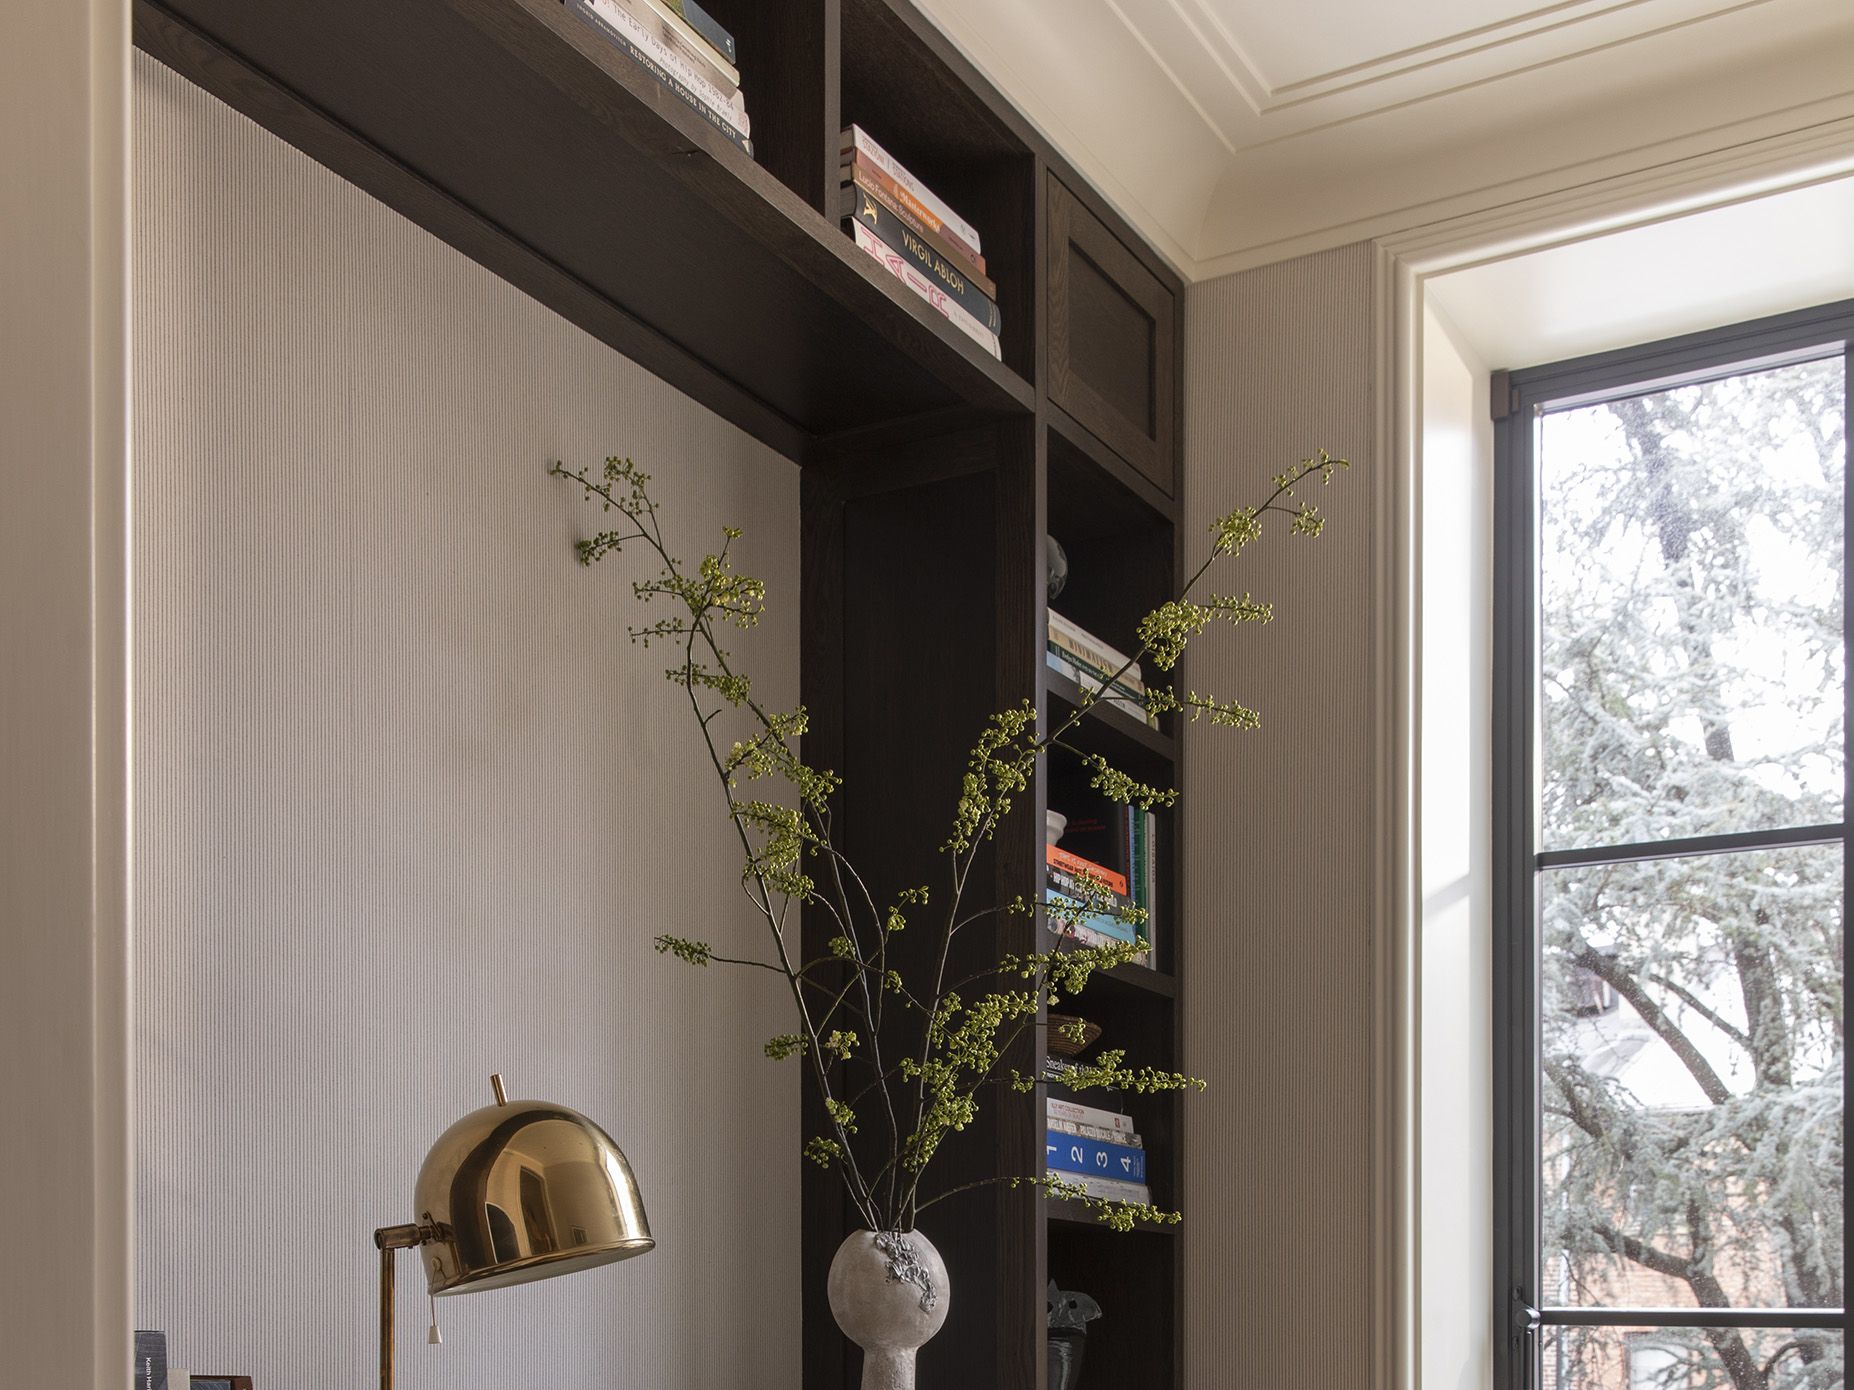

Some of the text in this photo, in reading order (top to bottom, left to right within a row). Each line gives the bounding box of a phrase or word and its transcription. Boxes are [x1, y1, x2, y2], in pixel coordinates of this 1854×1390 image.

[614, 4, 627, 22] The
[628, 17, 650, 41] Early
[650, 36, 668, 56] Days
[629, 45, 667, 81] RESTORING
[675, 83, 698, 107] HOUSE
[698, 99, 708, 113] IN
[708, 109, 721, 126] THE
[721, 120, 737, 138] CITY
[902, 229, 932, 268] VIRGIL
[934, 260, 965, 295] ABLOH
[1071, 1145, 1084, 1165] 2
[1096, 1151, 1108, 1169] 3
[1120, 1155, 1132, 1173] 4
